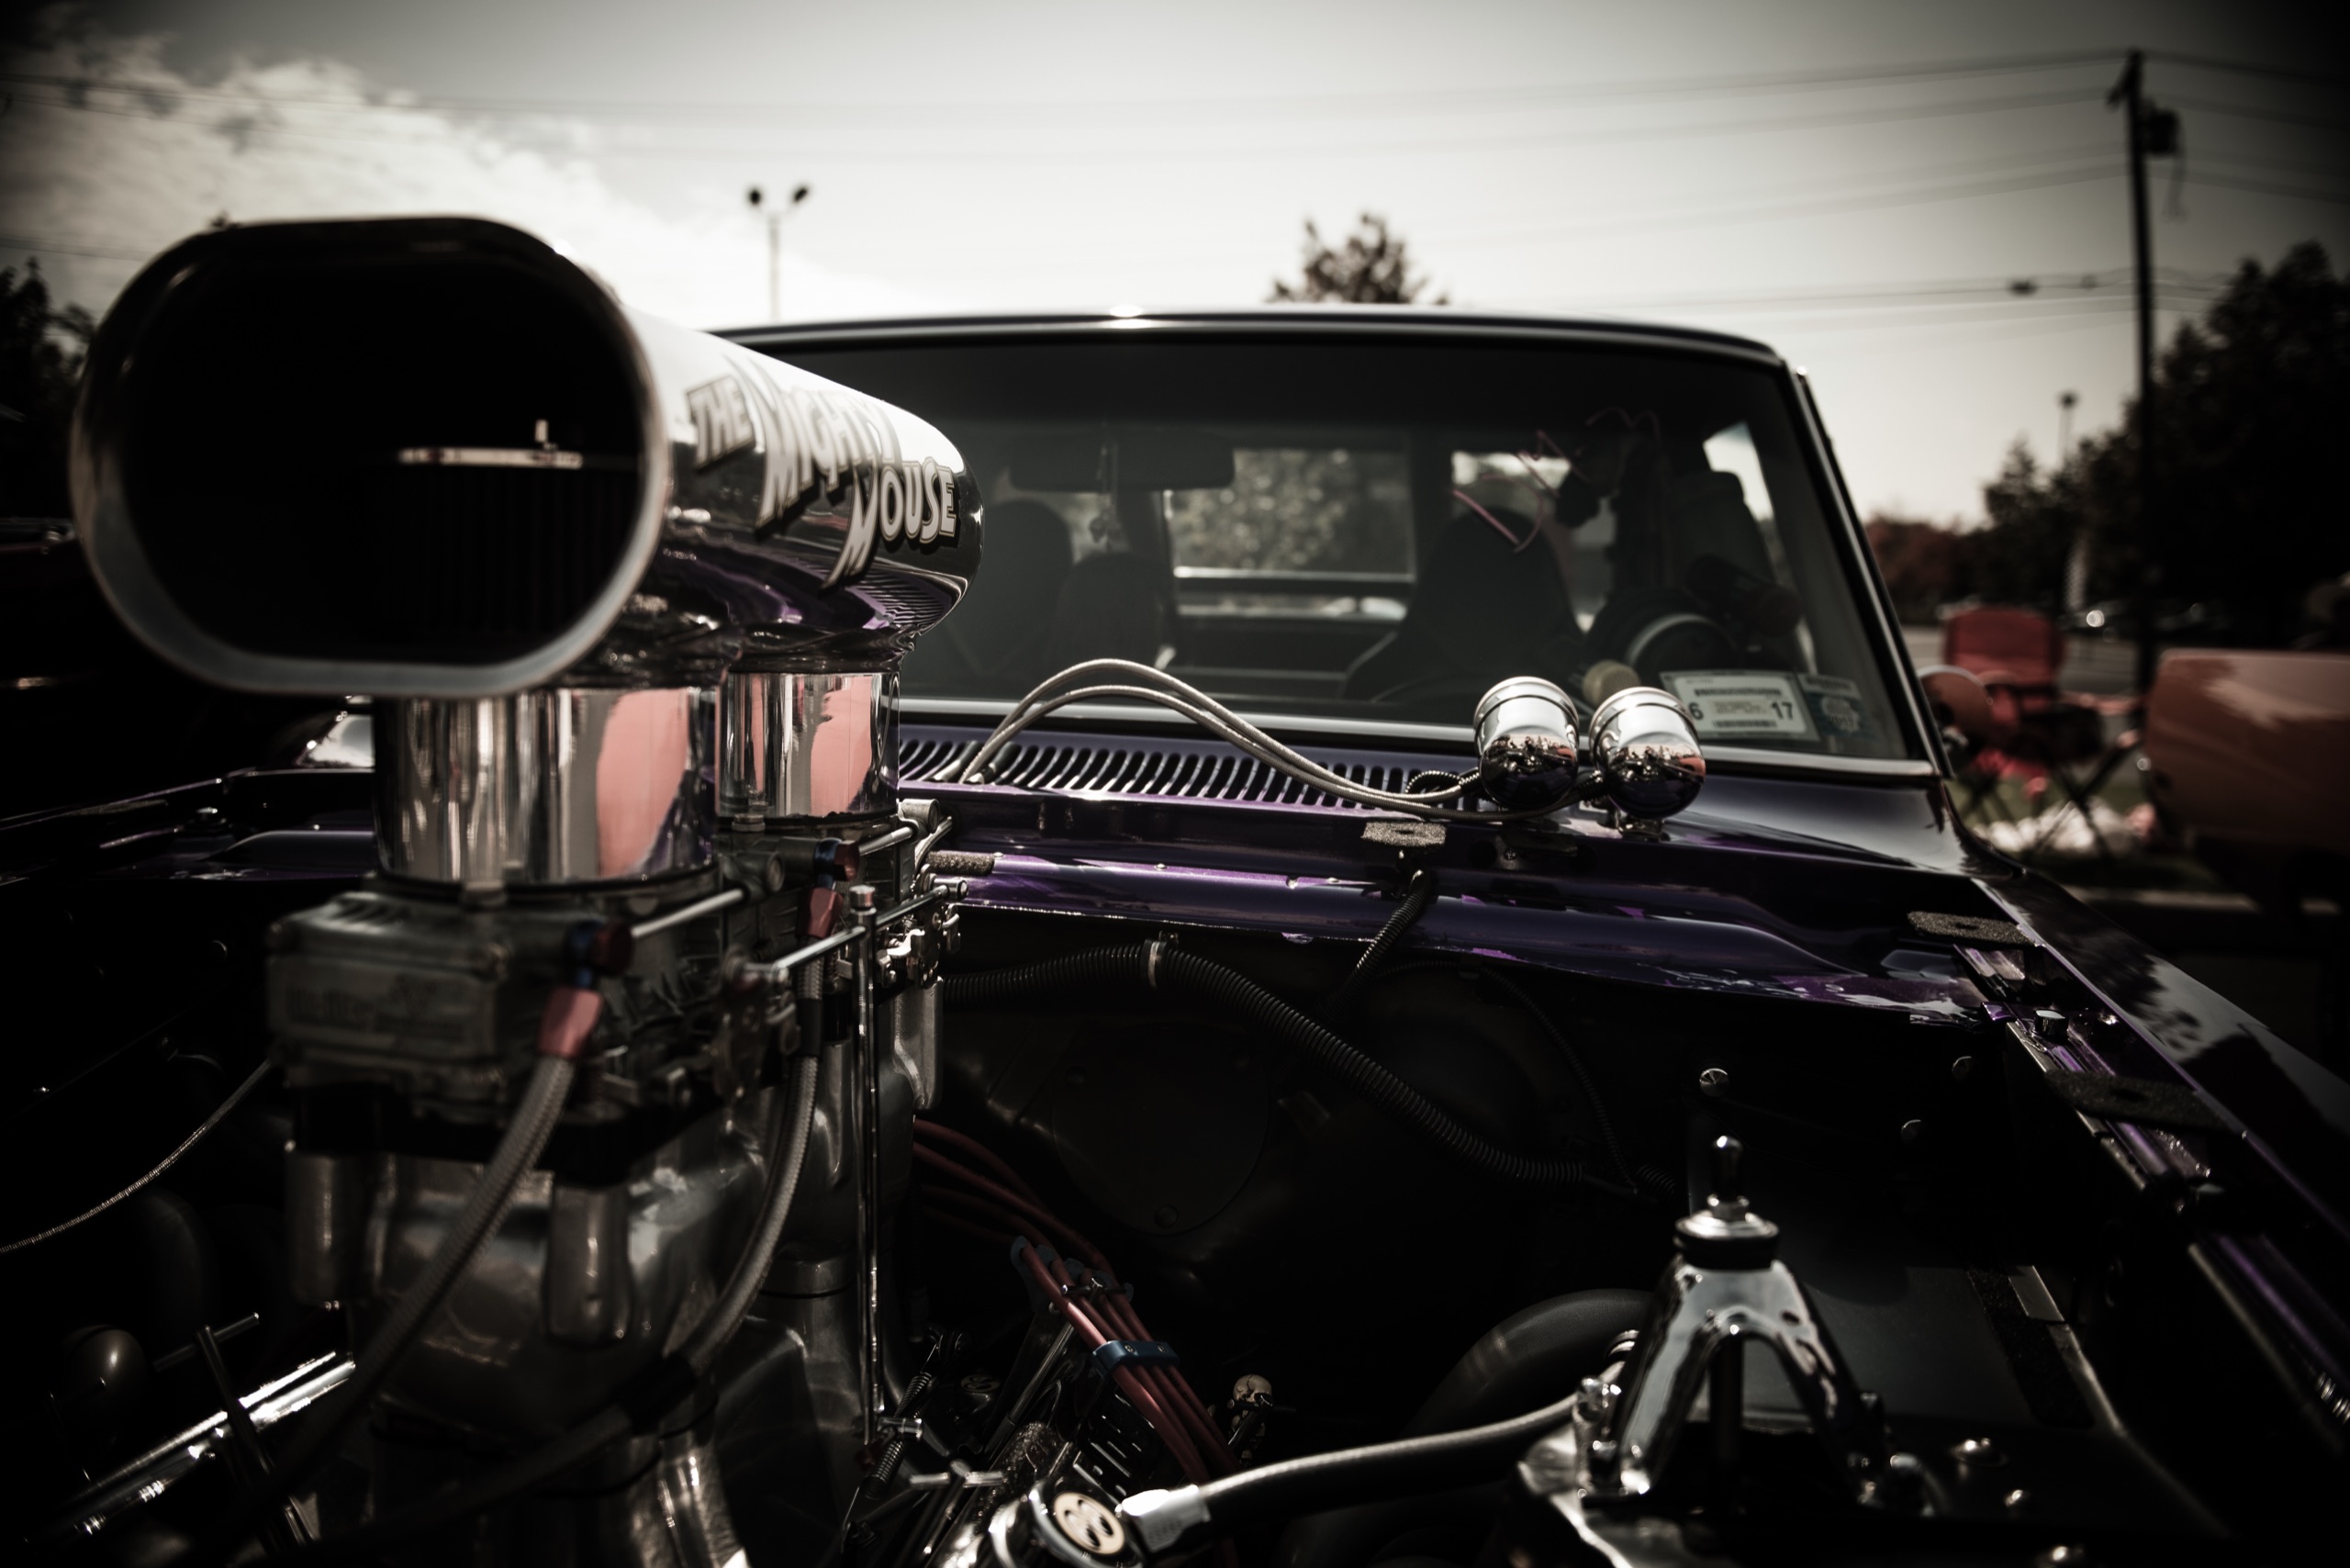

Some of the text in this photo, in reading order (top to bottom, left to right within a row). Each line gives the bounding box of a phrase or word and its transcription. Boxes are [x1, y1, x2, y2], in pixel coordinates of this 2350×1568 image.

[686, 353, 903, 532] THE MIGHTY
[820, 454, 957, 589] MOUSE
[1689, 701, 1705, 722] 6
[1771, 700, 1794, 721] 17
